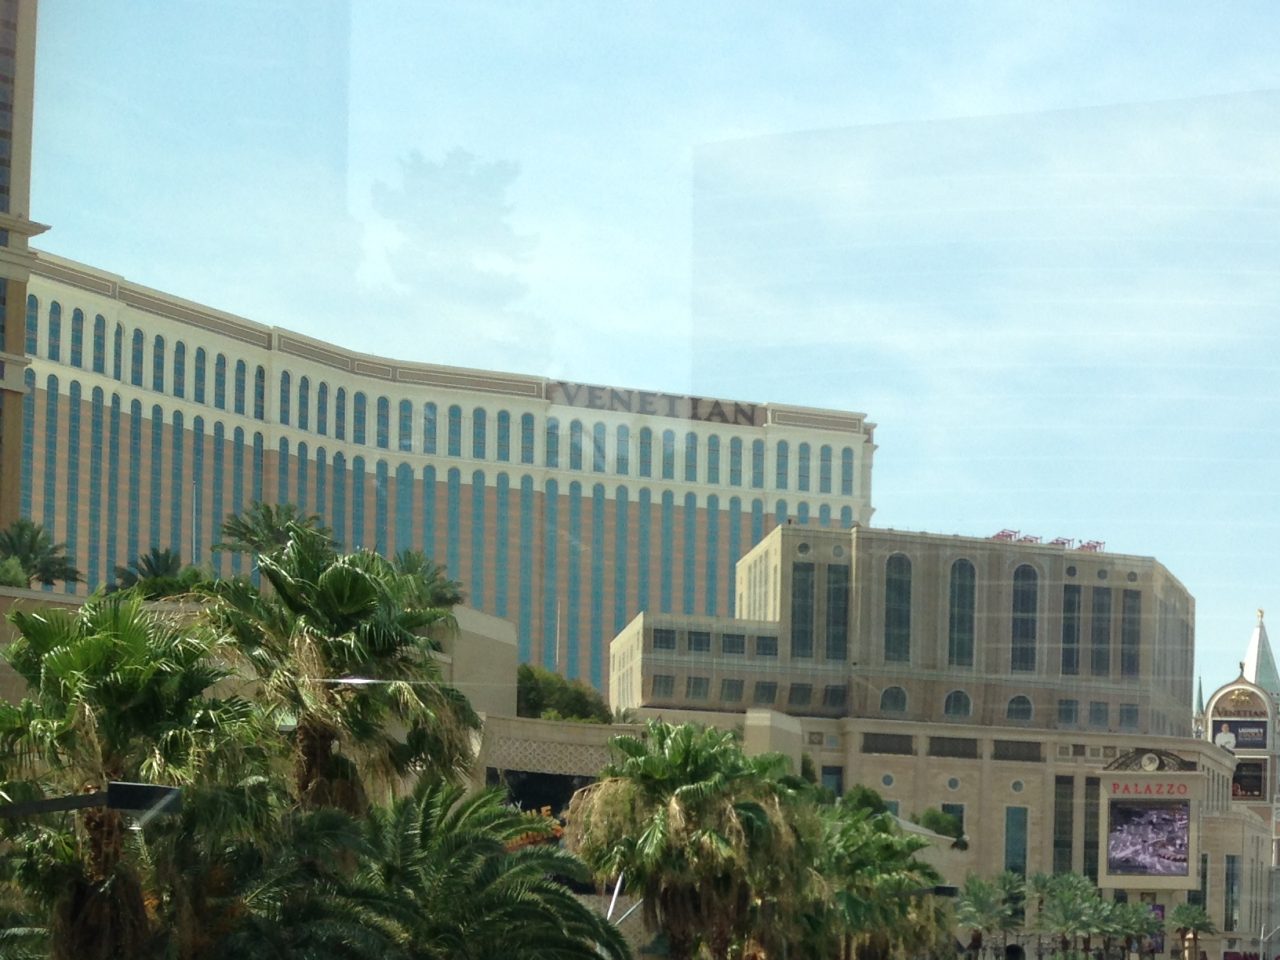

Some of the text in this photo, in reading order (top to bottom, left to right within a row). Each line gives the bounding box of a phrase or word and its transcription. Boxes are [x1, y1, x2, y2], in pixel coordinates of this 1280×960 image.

[556, 381, 759, 427] VENETIAN
[1214, 706, 1267, 717] VENETIAN
[1112, 783, 1187, 794] PALAZZO
